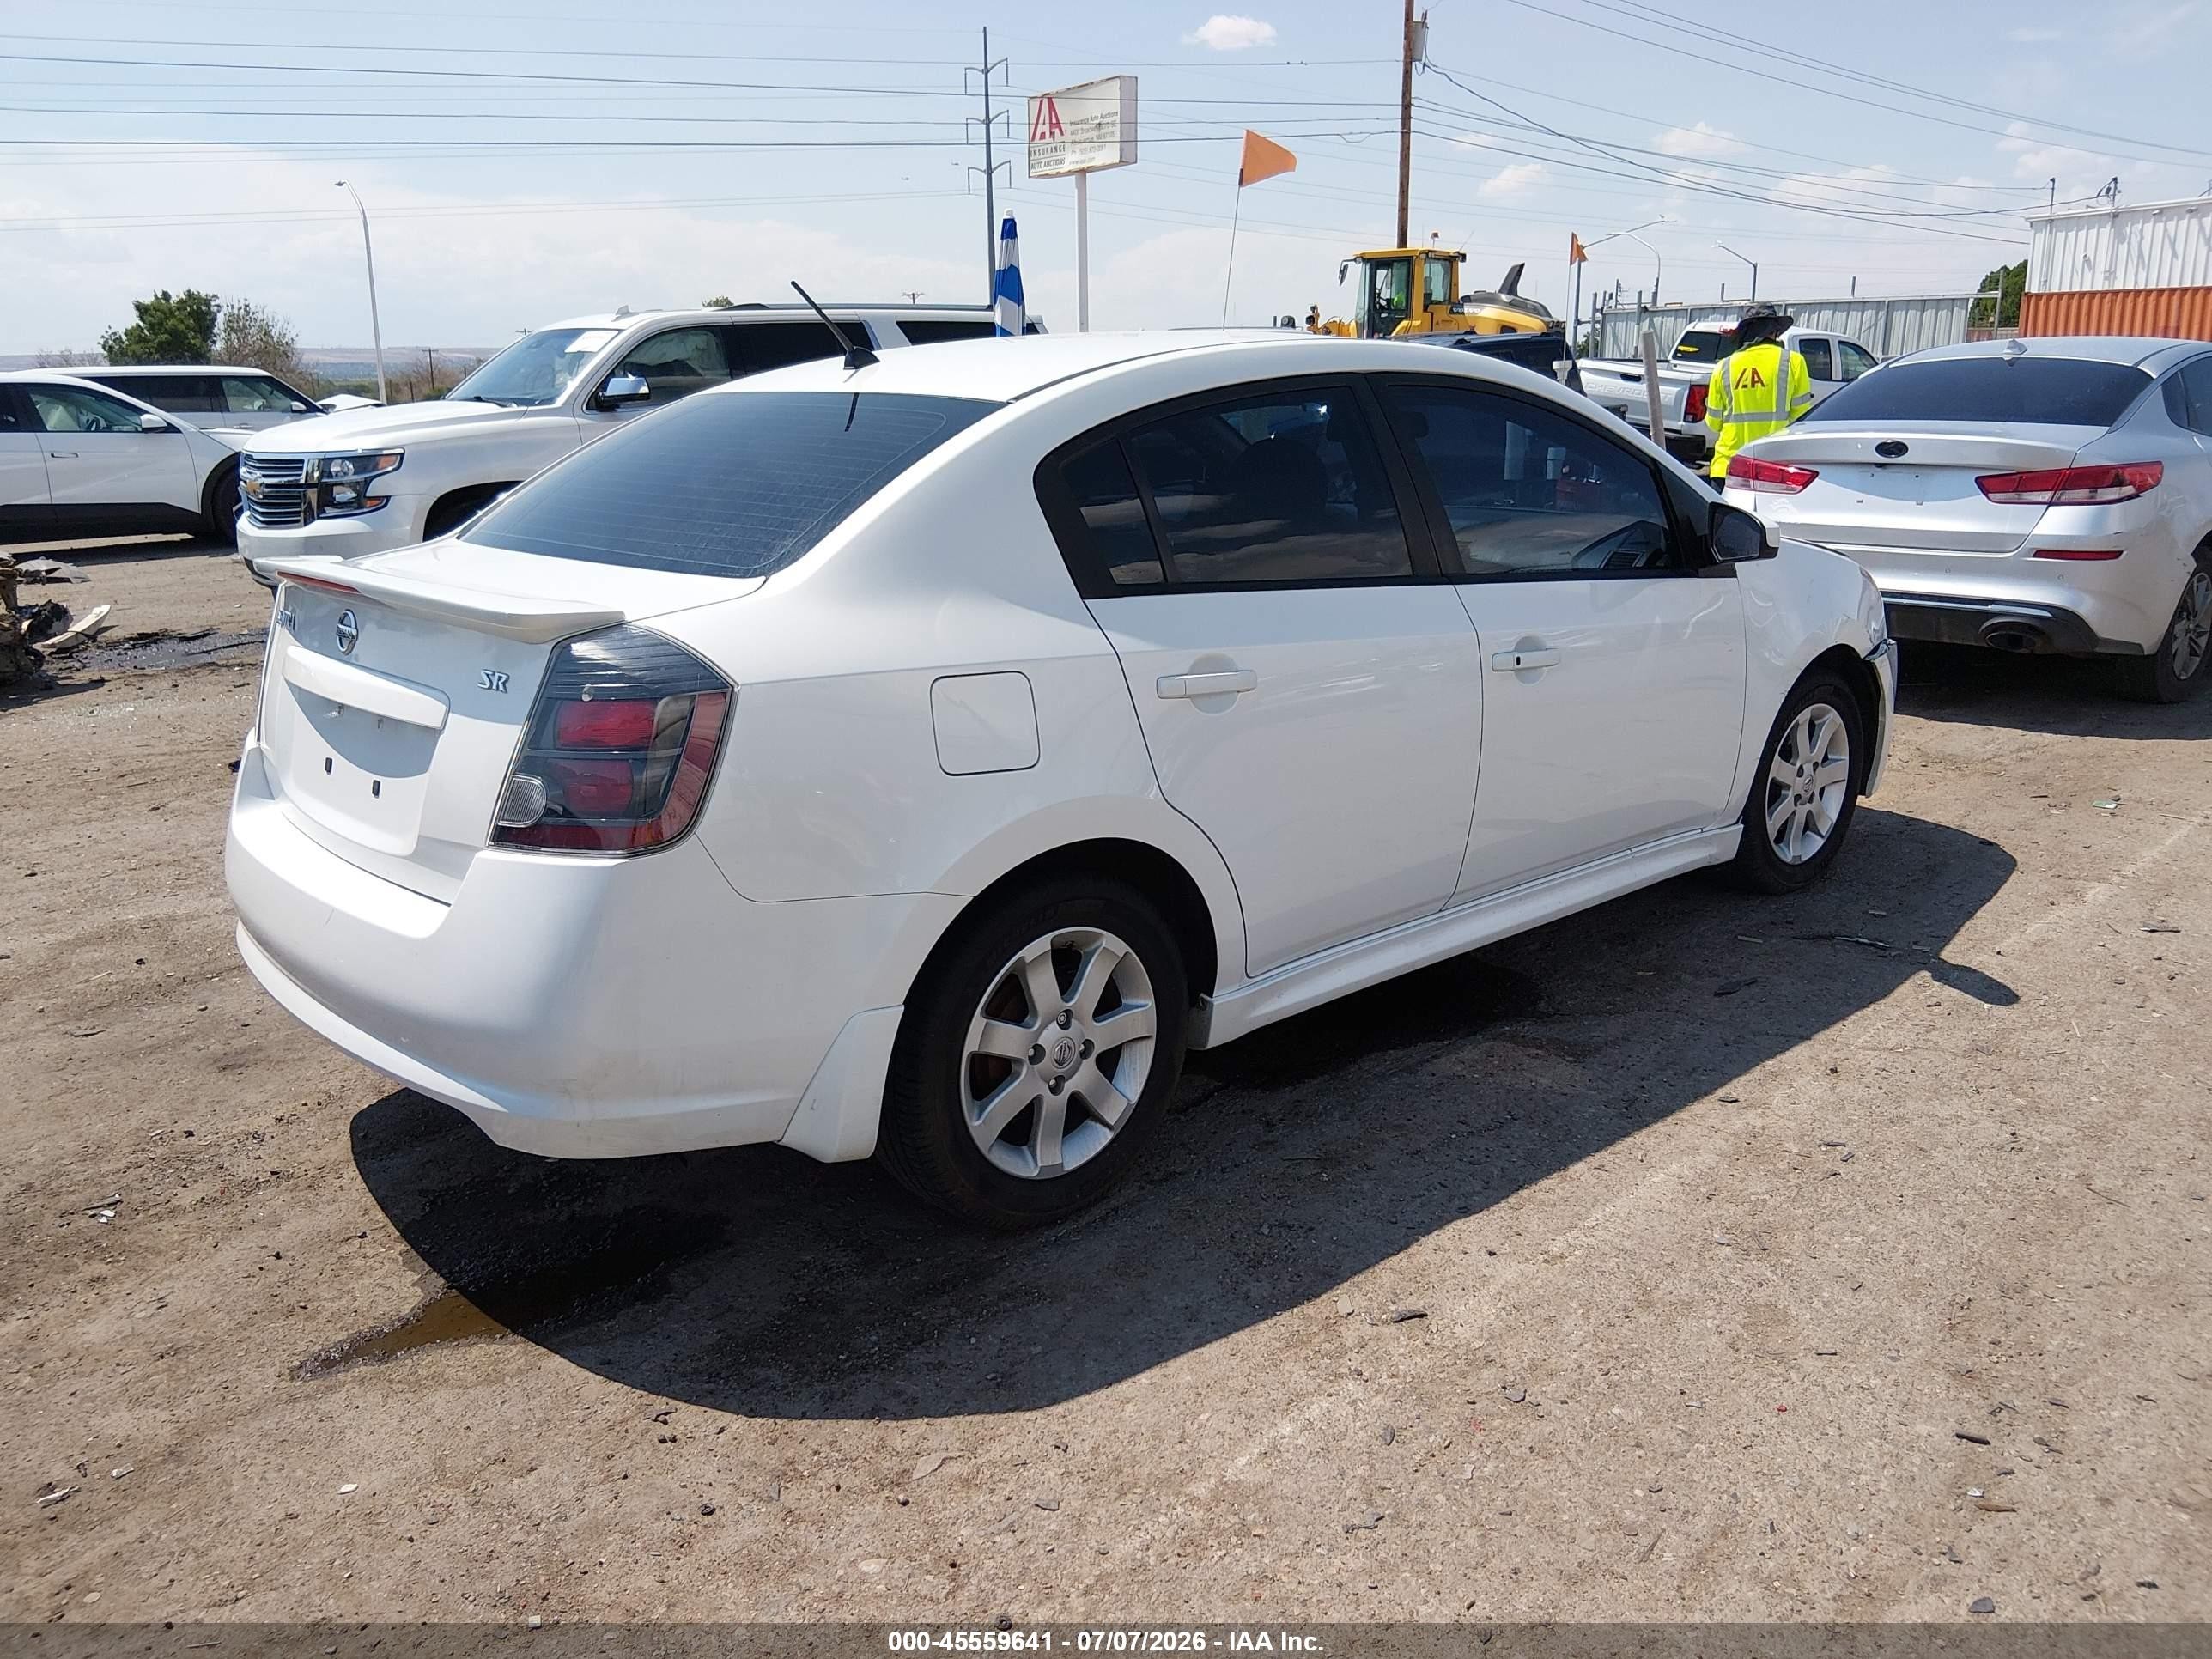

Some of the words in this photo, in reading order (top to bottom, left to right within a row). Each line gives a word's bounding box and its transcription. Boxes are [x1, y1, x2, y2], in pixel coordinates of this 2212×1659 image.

[1030, 144, 1066, 157] INSURANCE
[1030, 161, 1043, 170] AUTO
[1043, 157, 1066, 167] AUCTIONS
[477, 669, 510, 694] SR
